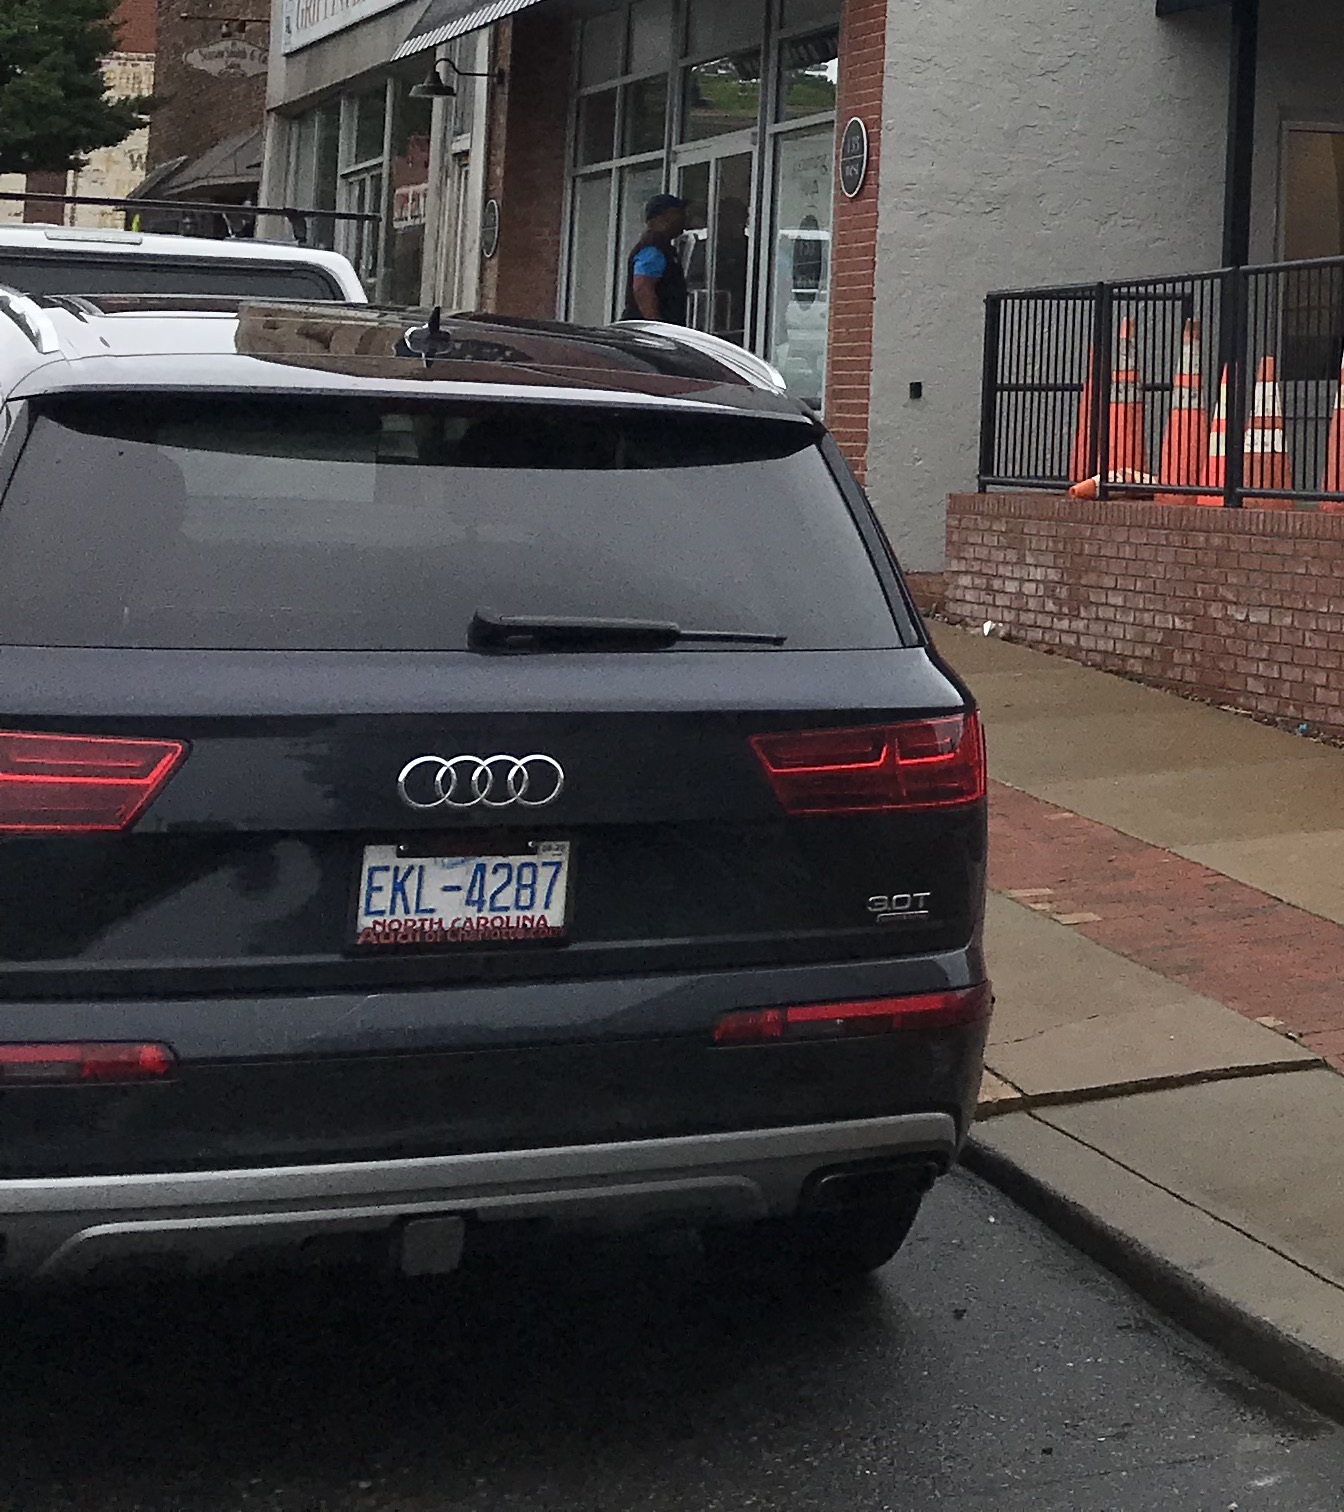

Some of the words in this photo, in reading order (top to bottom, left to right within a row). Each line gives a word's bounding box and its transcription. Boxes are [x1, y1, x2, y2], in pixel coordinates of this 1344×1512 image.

[363, 860, 563, 917] EKL-4287
[373, 917, 443, 933] NORTH
[450, 915, 549, 931] CAROLINA
